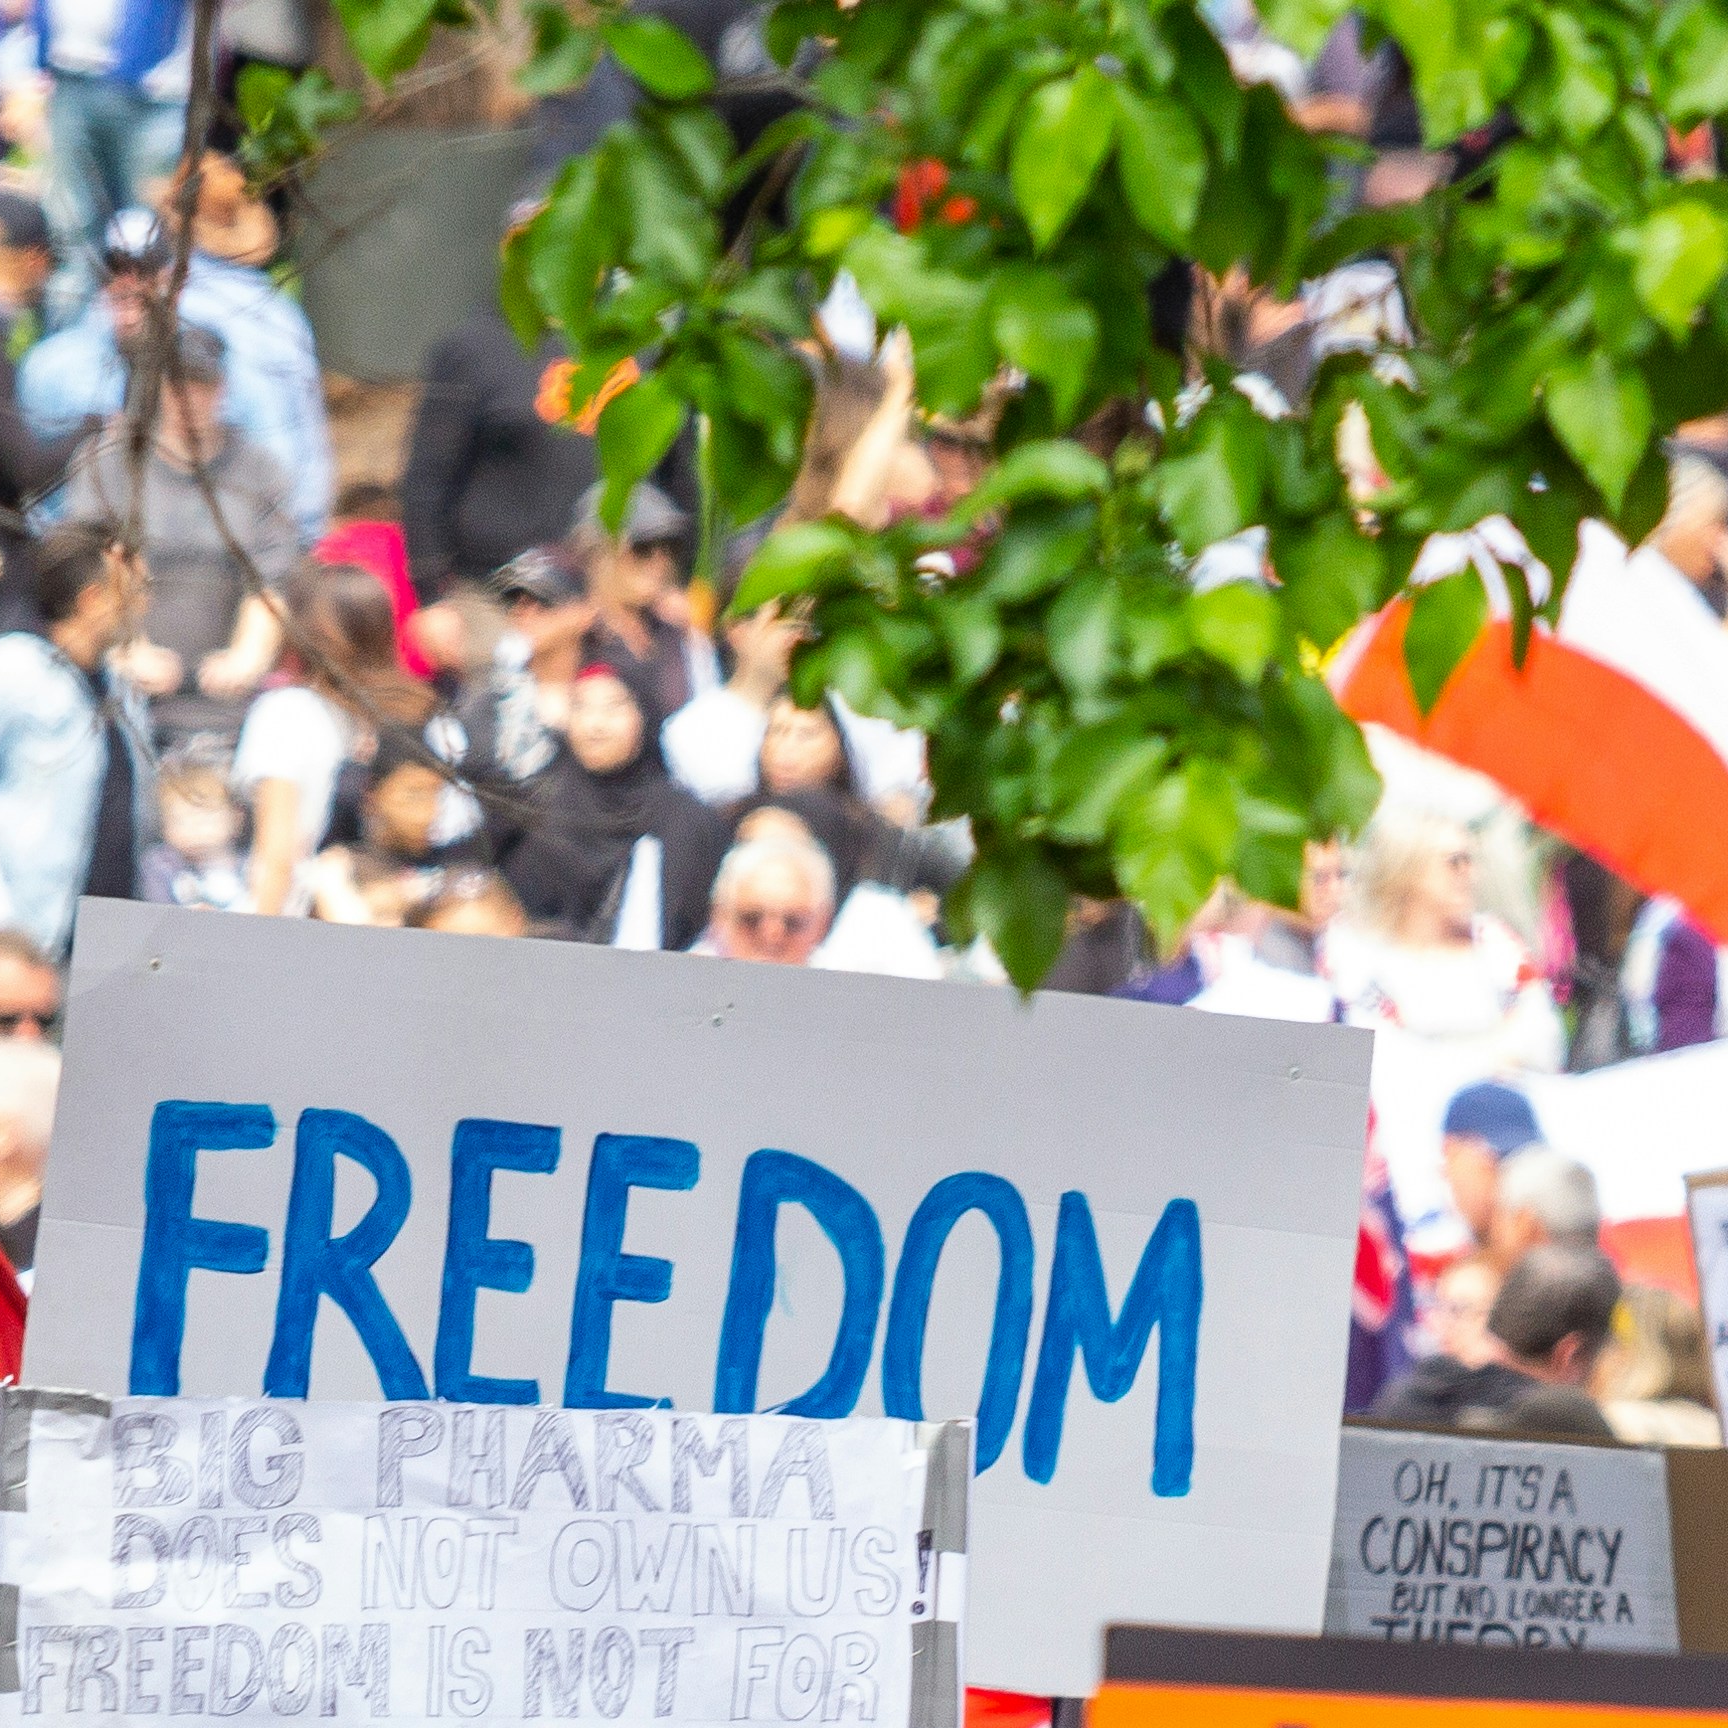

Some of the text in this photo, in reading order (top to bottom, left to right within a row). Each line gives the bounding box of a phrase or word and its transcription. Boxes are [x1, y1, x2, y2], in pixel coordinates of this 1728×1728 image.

[130, 1101, 1202, 1497] FREEDOM
[111, 1405, 837, 1521] BIG PHARMA
[1550, 1467, 1578, 1515] A
[110, 1511, 324, 1611] DOES
[361, 1513, 518, 1612] NOT
[548, 1517, 757, 1617] OWN
[1359, 1514, 1623, 1586] CONSPIRACY
[1389, 1581, 1448, 1615] BUT
[1614, 1591, 1636, 1626] A
[20, 1622, 881, 1723] FREEDOM IS NOT FOR
